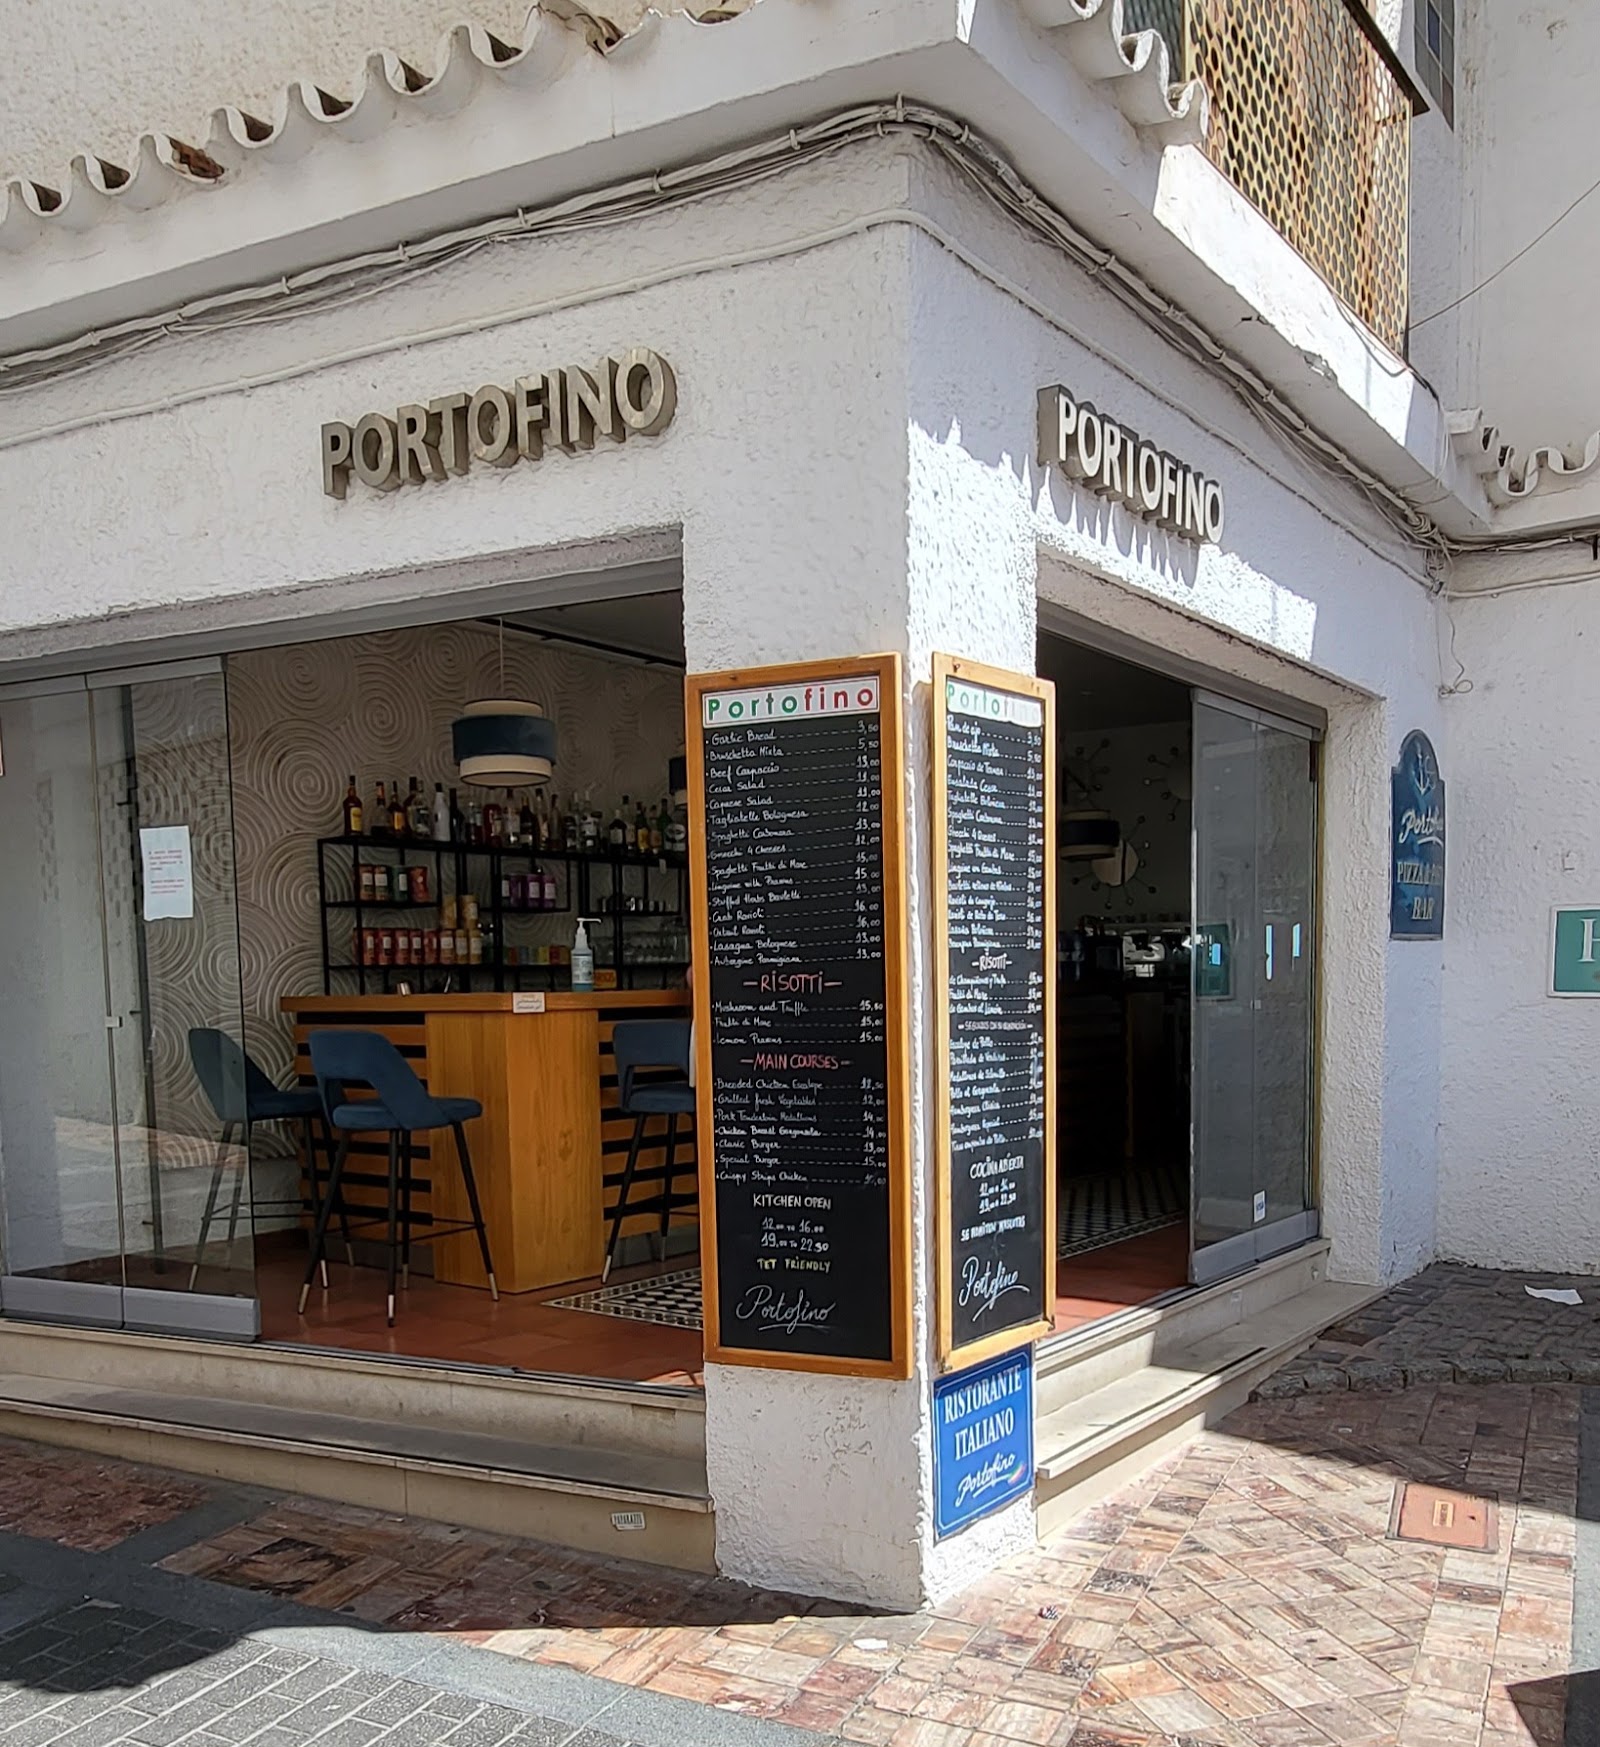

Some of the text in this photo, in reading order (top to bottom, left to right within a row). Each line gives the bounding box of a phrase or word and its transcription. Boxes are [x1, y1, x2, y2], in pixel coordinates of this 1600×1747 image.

[321, 348, 674, 500] PORTOFINO
[1051, 386, 1224, 543] PORTOFINO
[708, 687, 873, 721] Portofino
[712, 731, 743, 745] Garlic
[747, 728, 777, 742] Bread
[710, 747, 756, 760] Bruschetta
[710, 765, 732, 784] Beef
[737, 778, 766, 790] Salad
[747, 795, 774, 806] Salad
[747, 846, 752, 855] 4
[778, 860, 787, 870] di
[1411, 897, 1435, 920] BAR
[759, 1000, 778, 1011] and
[754, 1054, 838, 1070] MAIN COURSES
[751, 1139, 780, 1153] Burger
[753, 1194, 831, 1210] KITCHEN OPEN
[736, 1284, 836, 1334] Portofino
[944, 1364, 1022, 1424] RISTORANTE
[955, 1407, 1014, 1461] ITALIANO
[955, 1453, 1016, 1508] Portofino
